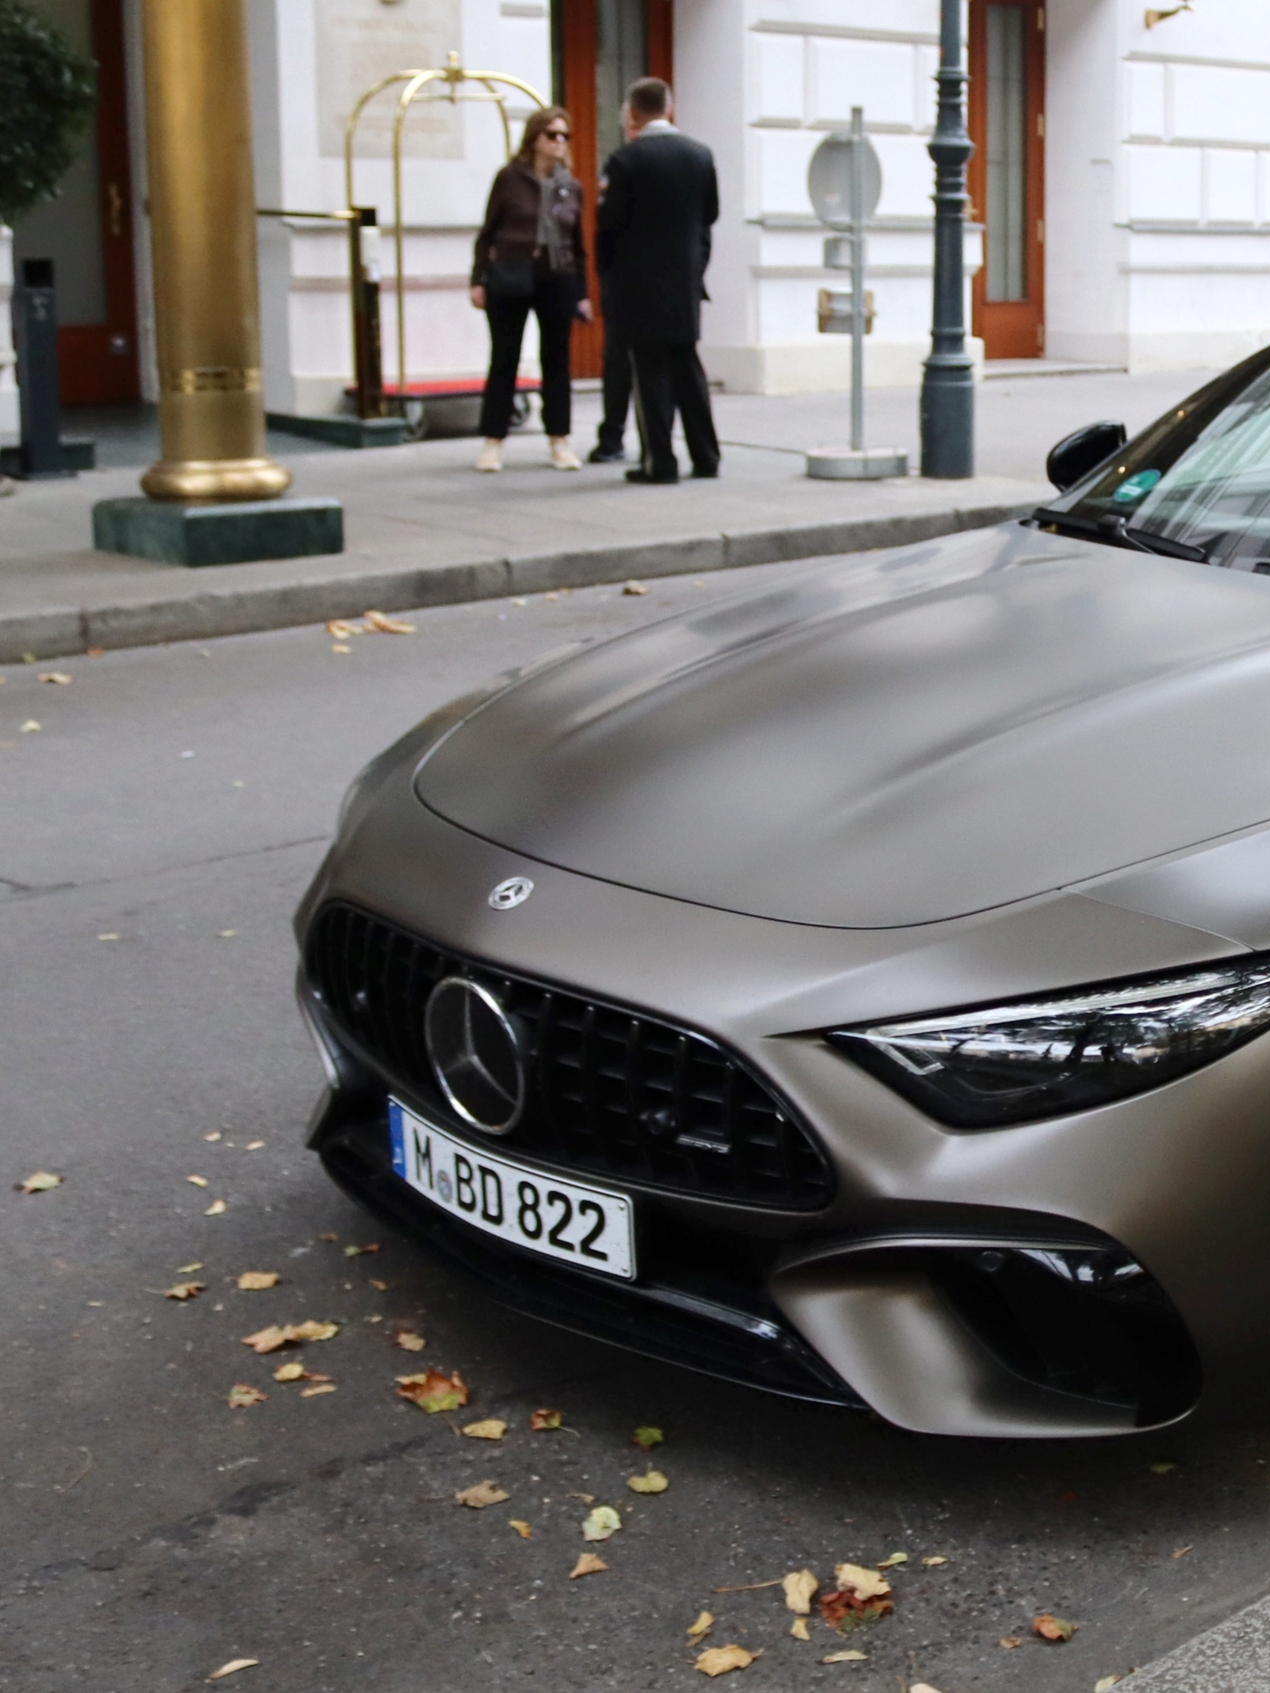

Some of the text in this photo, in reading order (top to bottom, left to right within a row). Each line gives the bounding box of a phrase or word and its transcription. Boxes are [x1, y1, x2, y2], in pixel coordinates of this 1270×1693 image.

[412, 1127, 609, 1262] M BD 822
